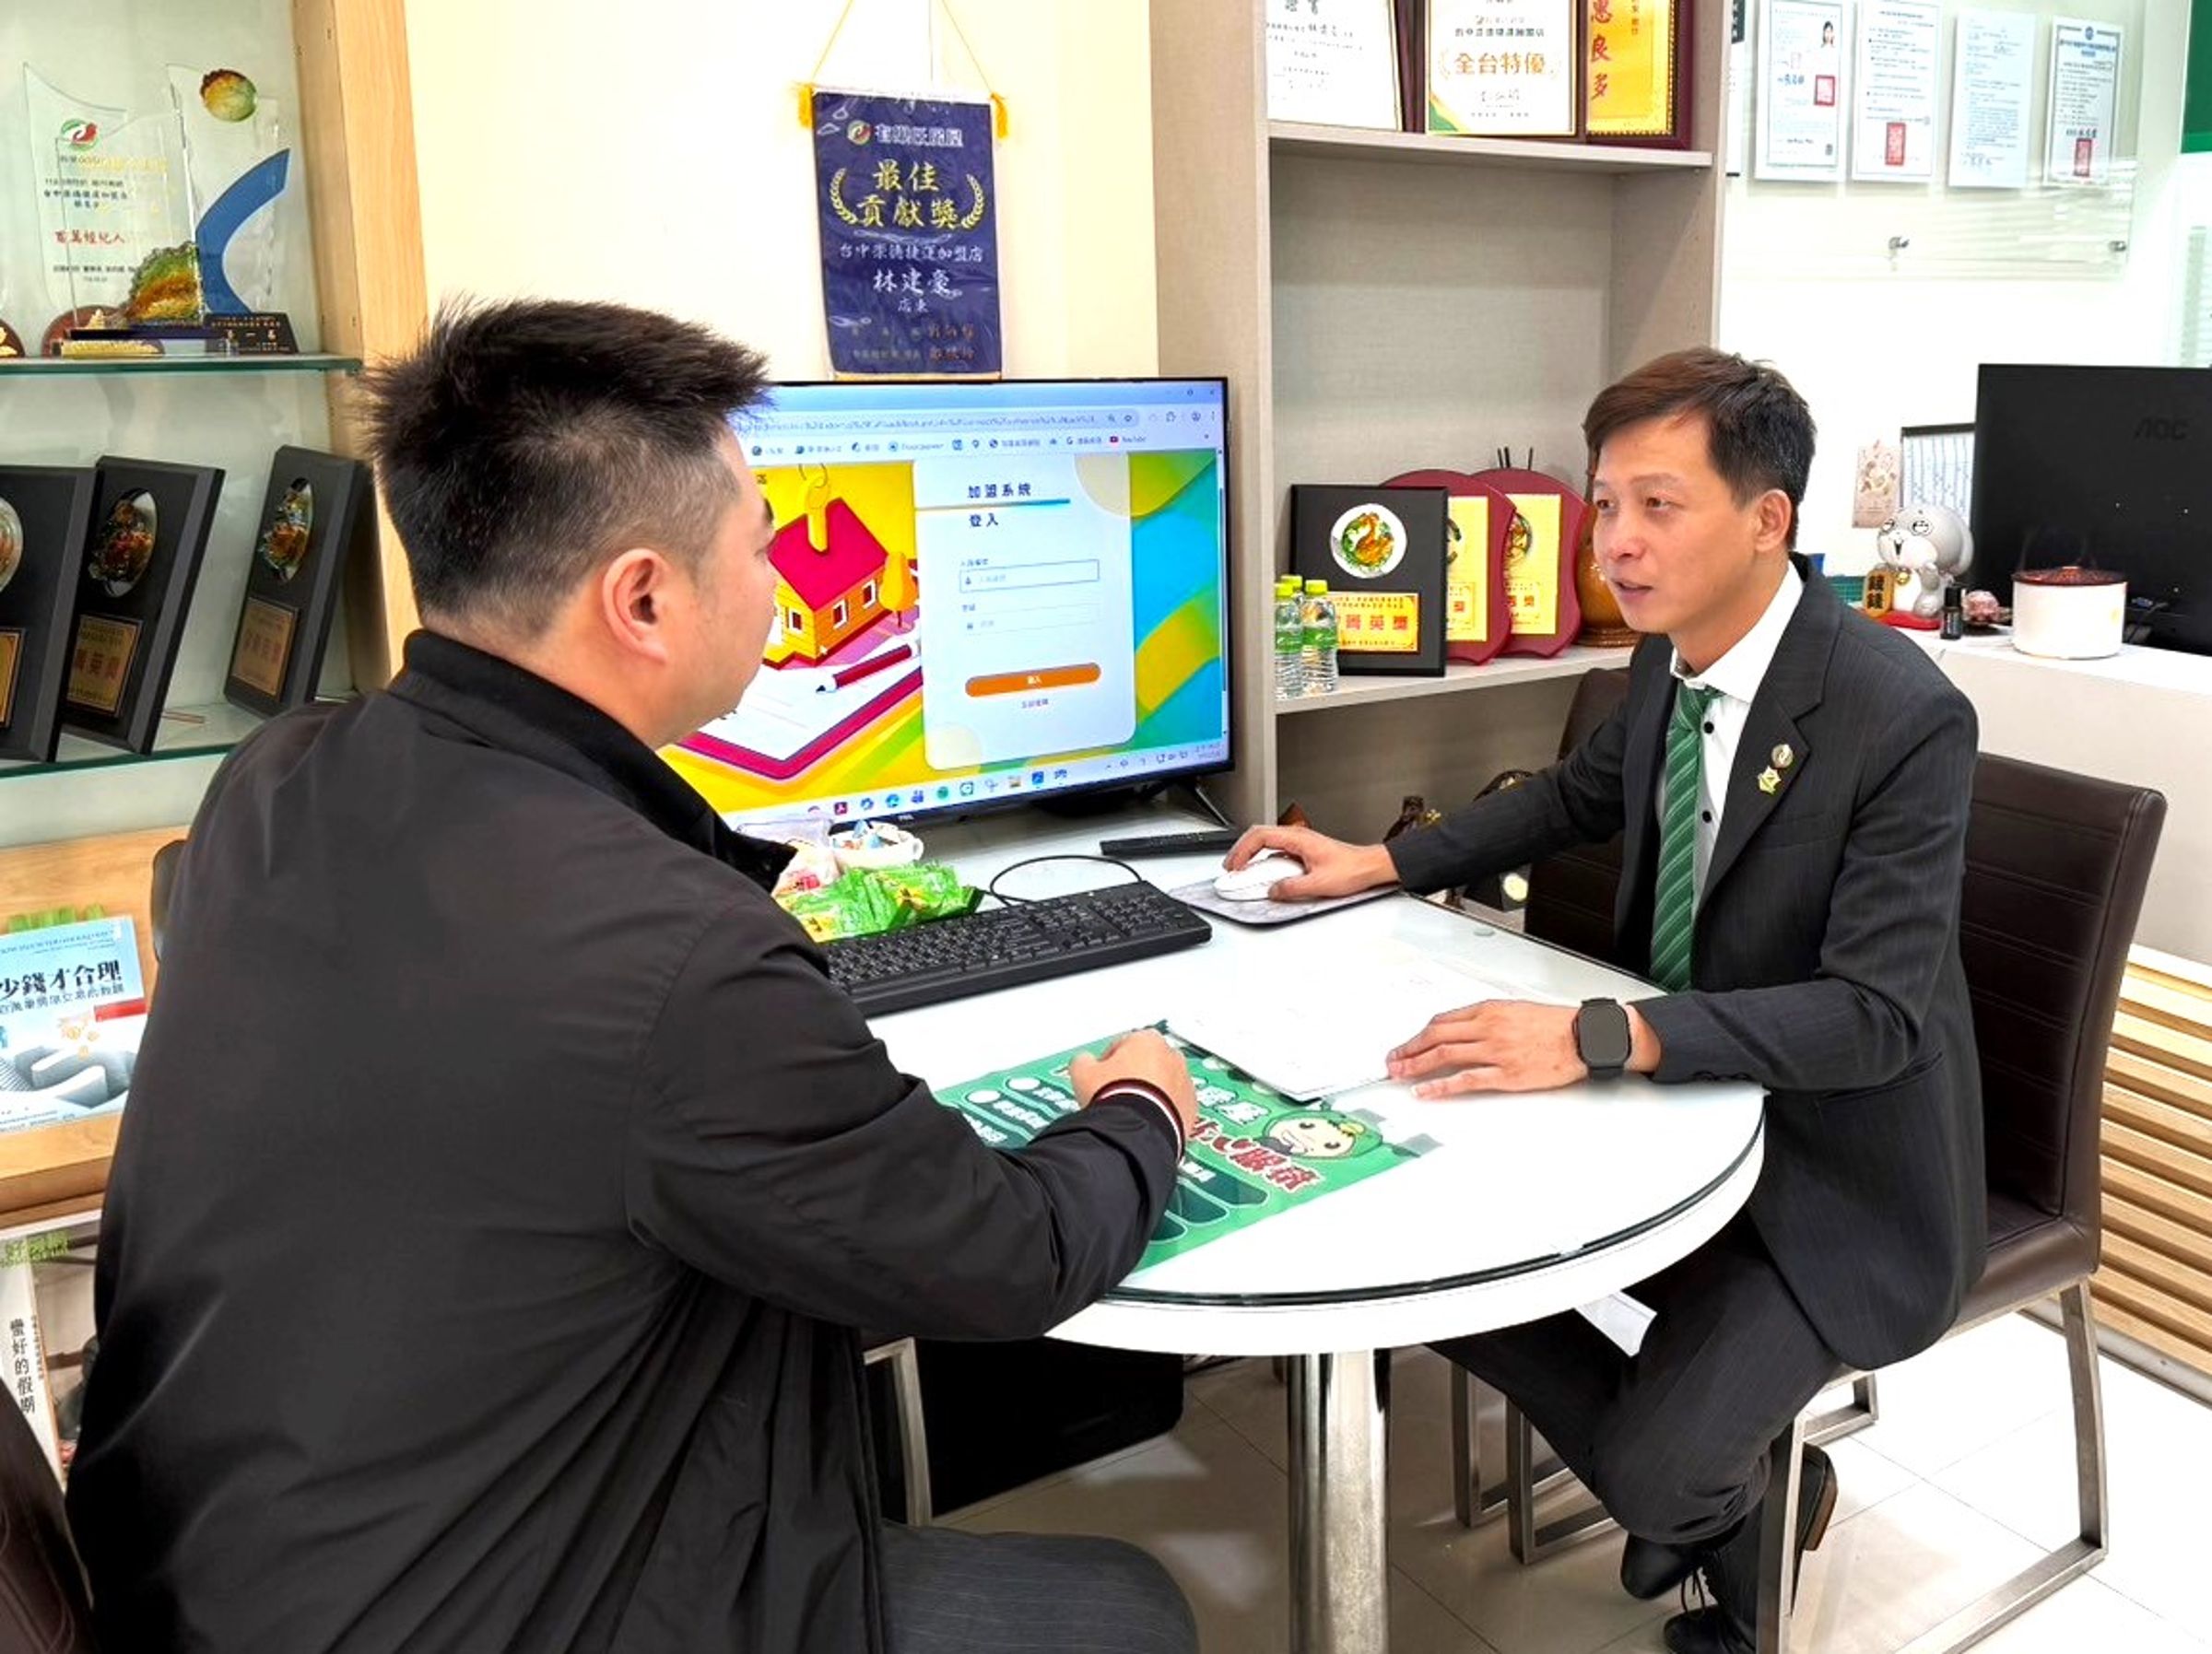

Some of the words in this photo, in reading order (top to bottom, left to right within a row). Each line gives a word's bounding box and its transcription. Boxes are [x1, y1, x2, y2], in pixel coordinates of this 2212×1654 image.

[1454, 52, 1546, 75] 全台特優
[873, 158, 939, 193] 最佳
[2133, 416, 2190, 440] AOC
